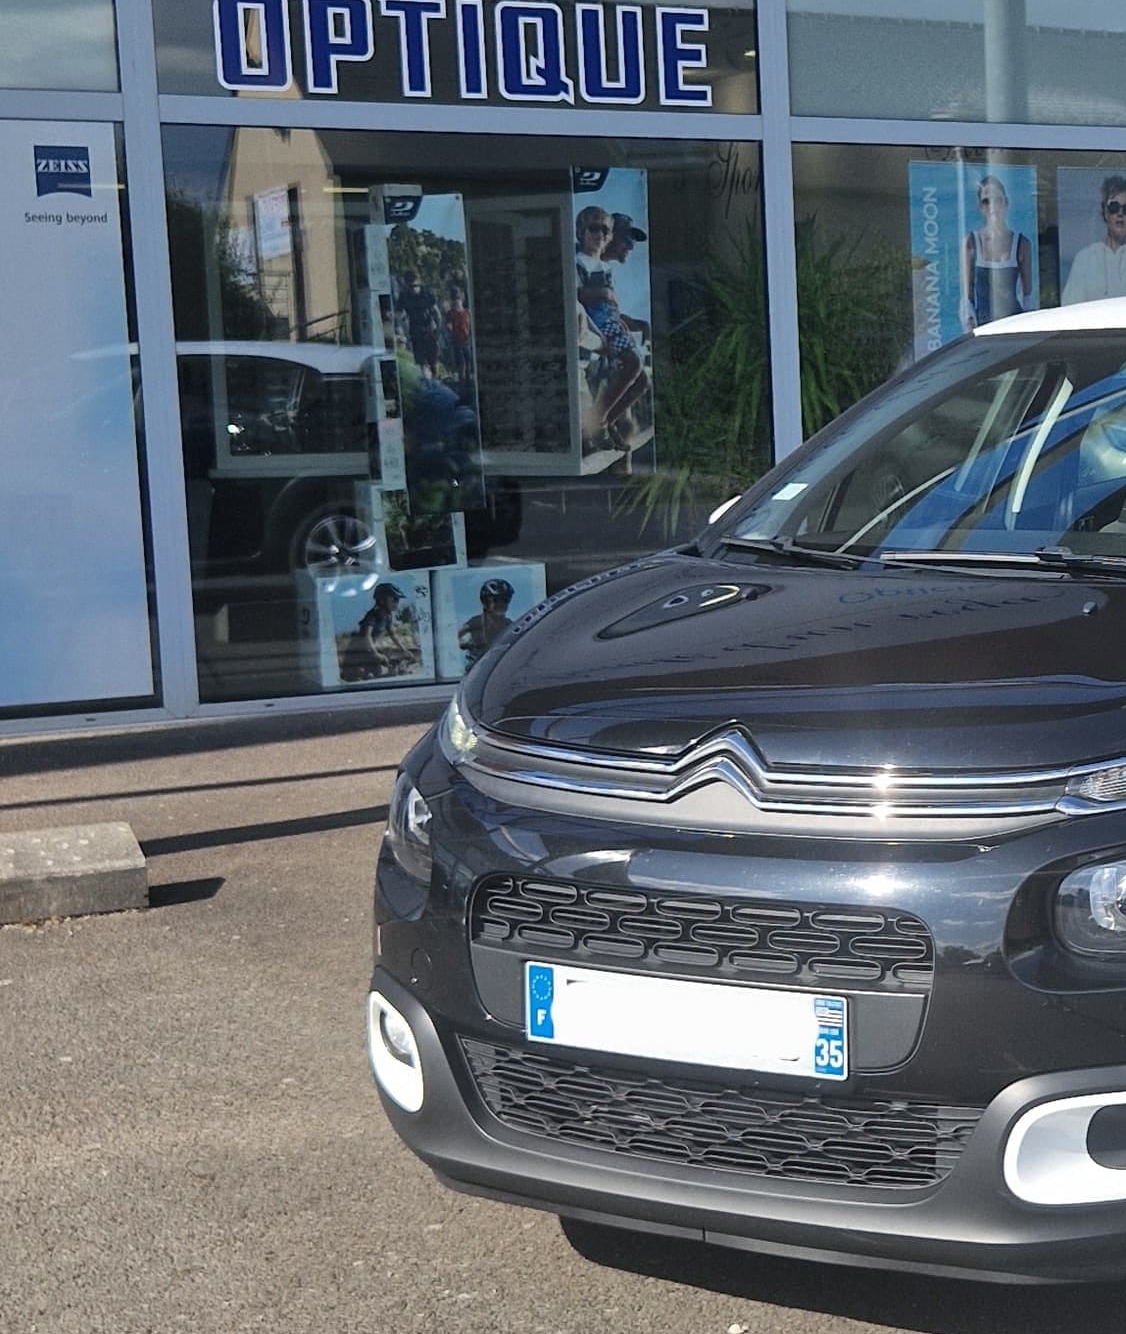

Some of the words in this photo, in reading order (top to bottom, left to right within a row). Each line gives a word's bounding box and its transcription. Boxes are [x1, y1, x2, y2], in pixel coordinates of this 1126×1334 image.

[36, 159, 89, 173] ZEISS
[24, 212, 63, 225] Seeing
[66, 212, 108, 226] beyond
[922, 186, 940, 255] MOON
[924, 260, 942, 352] BANANA
[537, 1008, 547, 1026] F
[815, 1037, 843, 1068] 35
